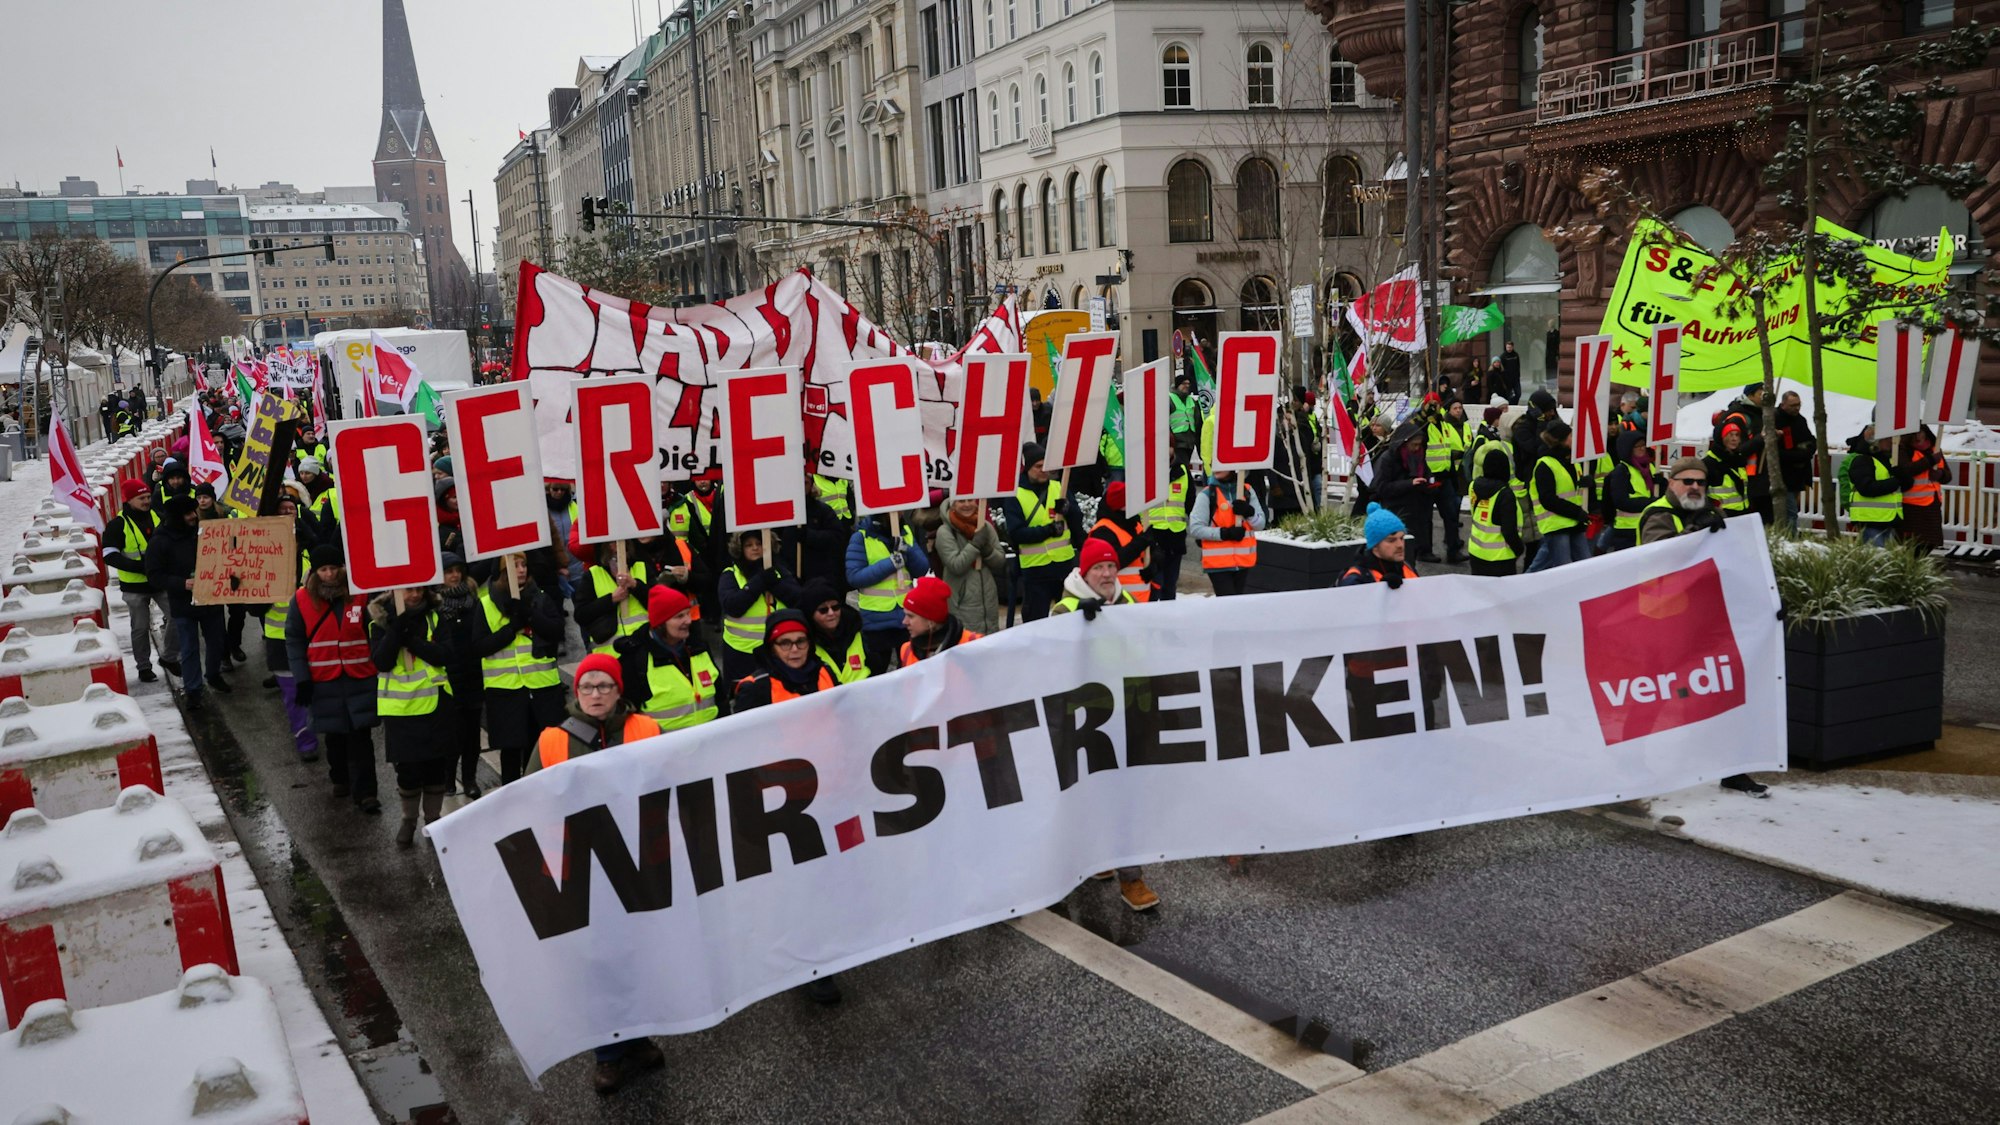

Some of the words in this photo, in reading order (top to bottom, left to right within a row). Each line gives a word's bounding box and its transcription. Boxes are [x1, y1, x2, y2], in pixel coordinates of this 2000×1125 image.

[1681, 303, 1800, 345] Aufwetung
[201, 542, 217, 556] ein
[248, 540, 284, 556] braucht
[240, 569, 261, 580] sind
[1600, 654, 1734, 707] ver.di
